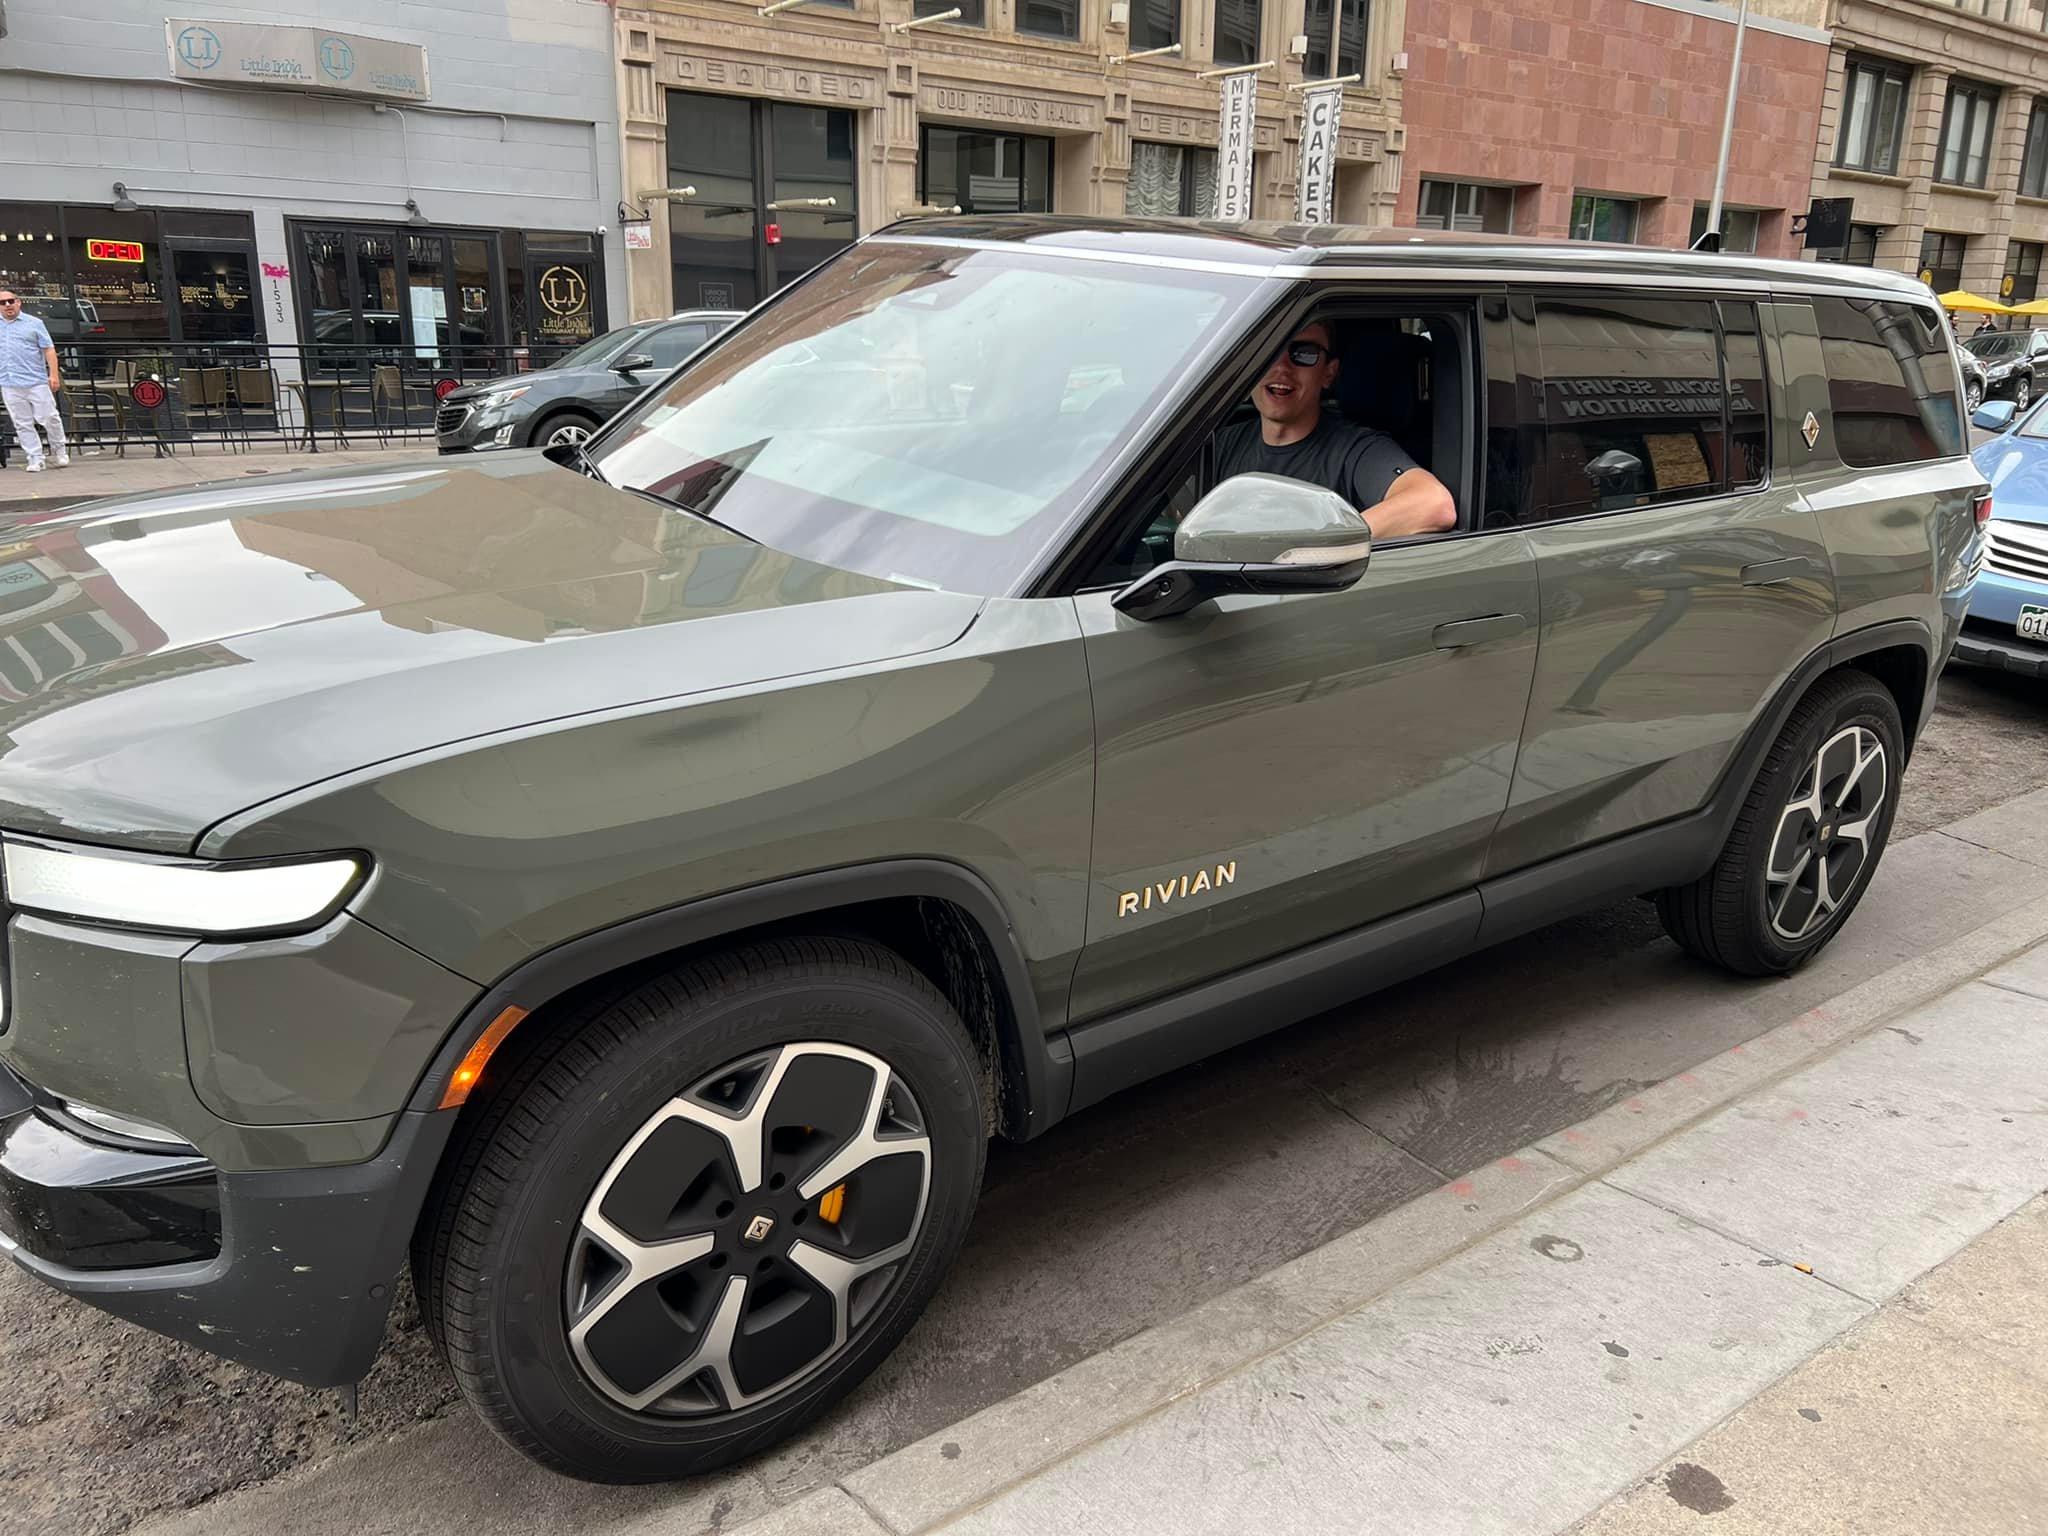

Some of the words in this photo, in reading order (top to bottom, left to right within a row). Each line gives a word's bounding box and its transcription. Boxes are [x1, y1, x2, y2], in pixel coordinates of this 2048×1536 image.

[183, 35, 215, 60] LI
[937, 89, 968, 112] ODD
[975, 94, 1040, 119] FELLOWS
[1047, 102, 1081, 124] HALL
[1225, 79, 1244, 217] MERMAIDS
[1305, 102, 1328, 224] CAKES
[91, 242, 140, 261] OPEN
[272, 279, 284, 323] 1533
[547, 278, 579, 304] LI
[1118, 861, 1237, 918] RIVIAN
